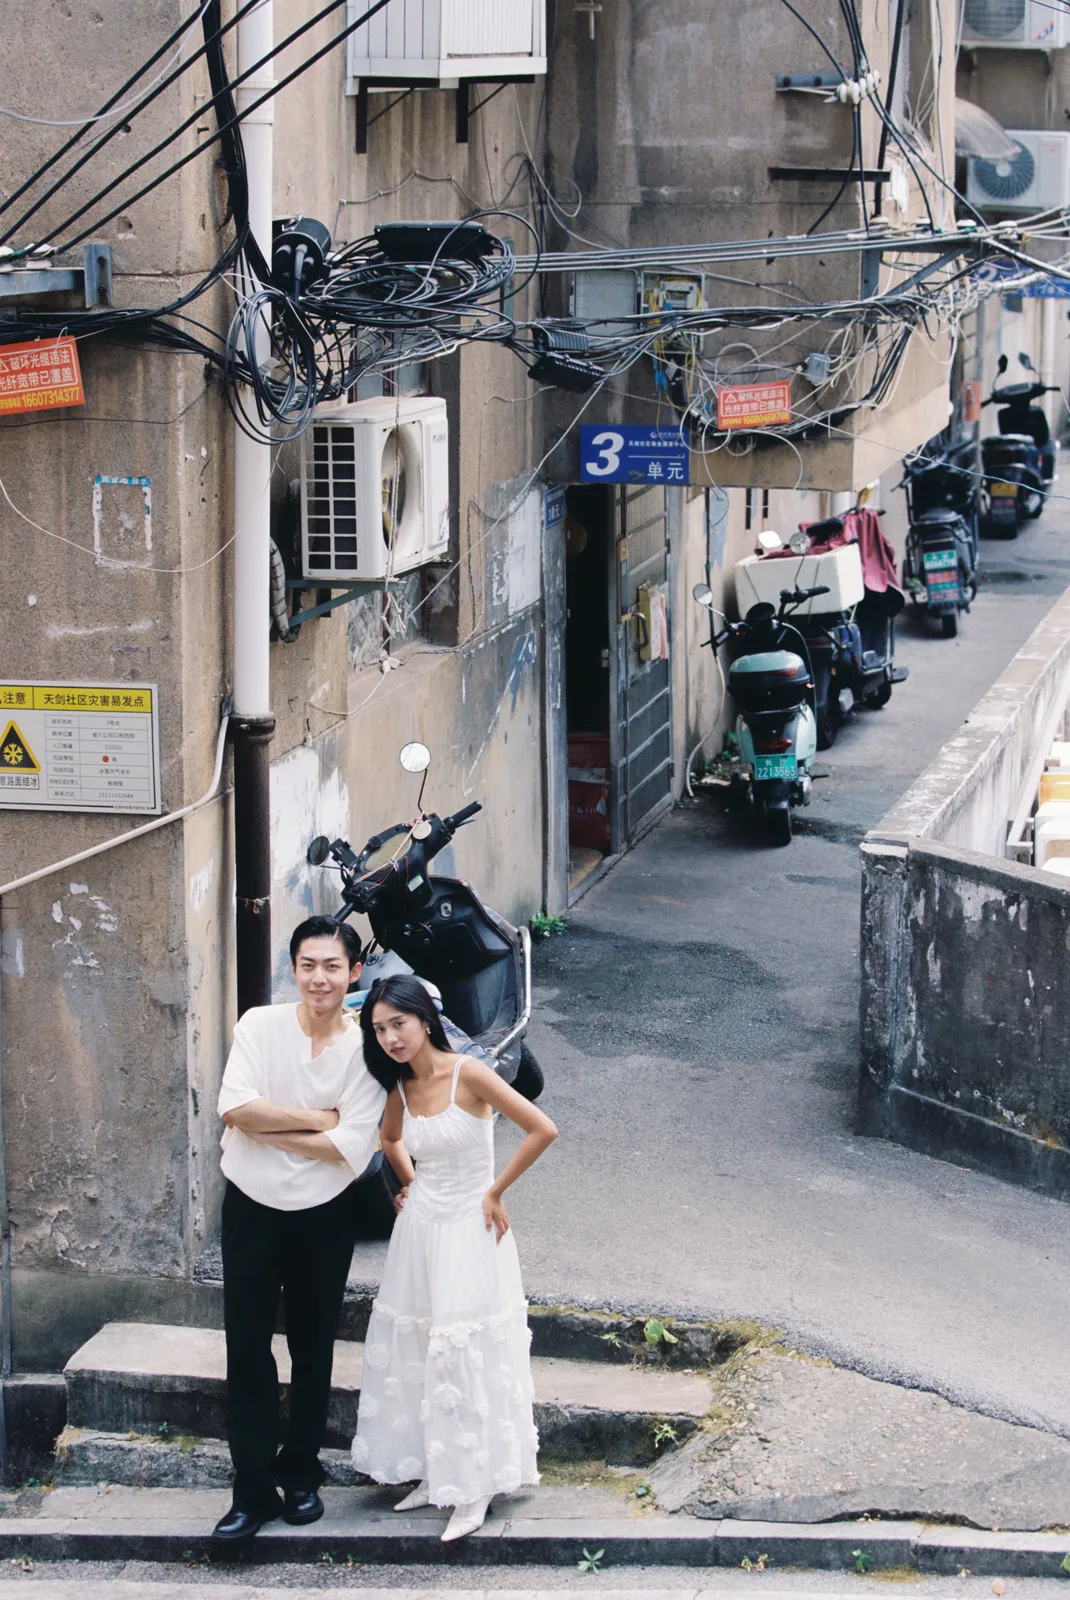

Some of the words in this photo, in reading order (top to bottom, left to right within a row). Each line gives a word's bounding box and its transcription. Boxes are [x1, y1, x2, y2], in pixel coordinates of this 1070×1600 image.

[22, 387, 80, 408] 16607314377
[585, 431, 625, 476] 3
[647, 461, 684, 480] 单元
[3, 691, 26, 705] 注意
[43, 693, 145, 708] 天剑社区灾害易发点
[757, 766, 796, 778] 2213563
